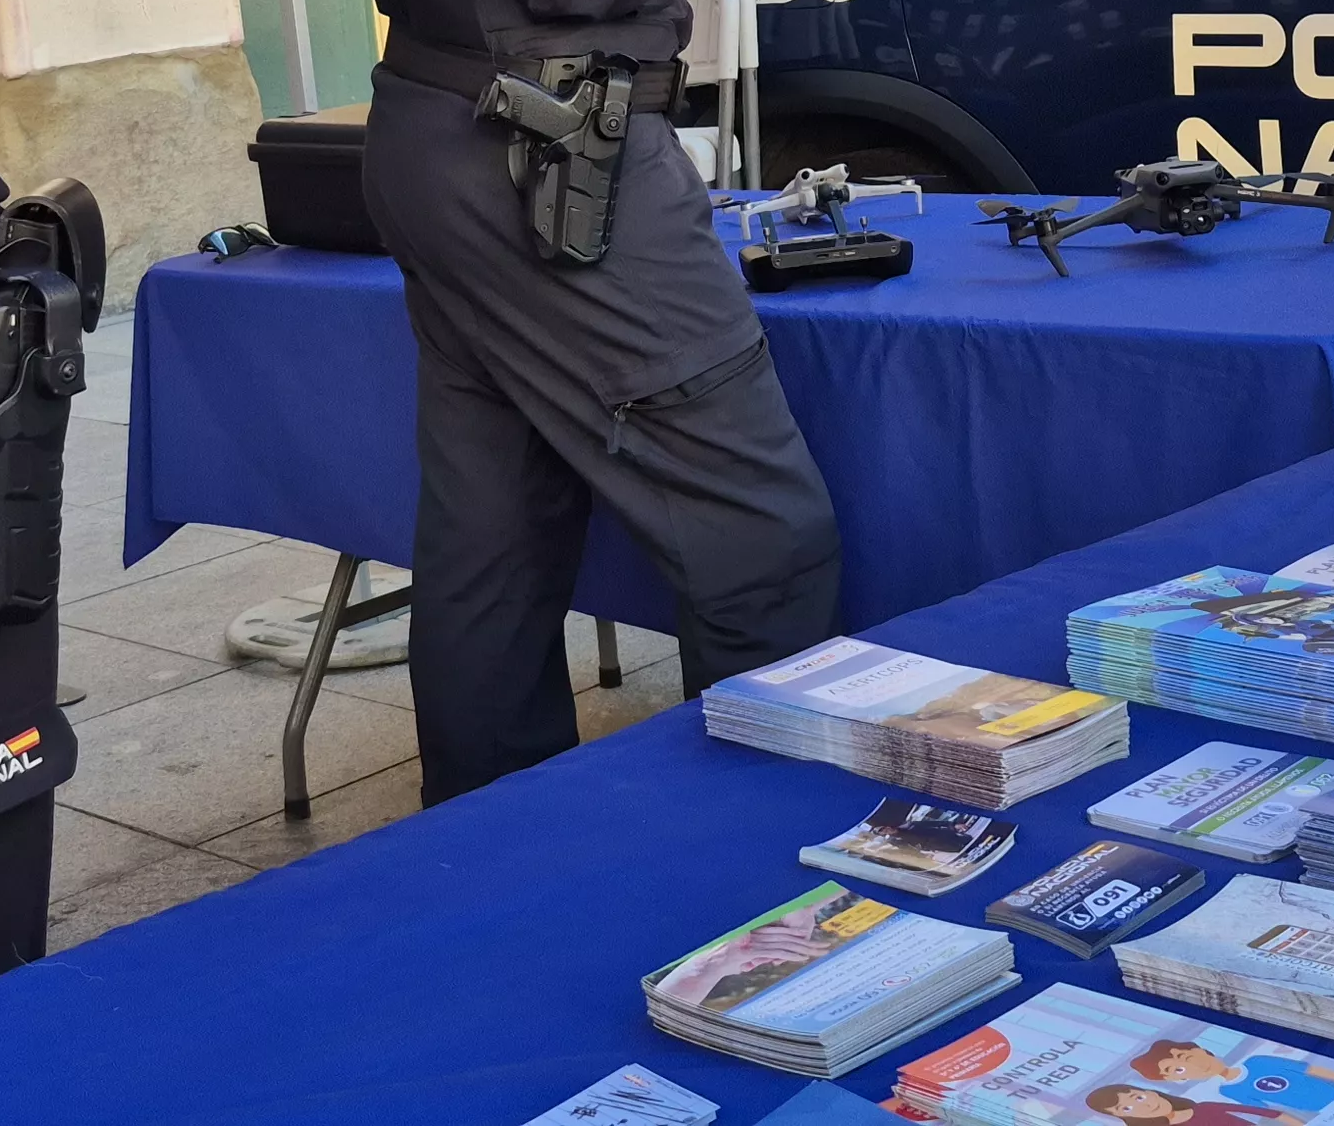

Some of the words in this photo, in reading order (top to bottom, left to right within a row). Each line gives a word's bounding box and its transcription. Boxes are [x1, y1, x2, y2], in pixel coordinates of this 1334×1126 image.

[827, 657, 924, 696] ALERTCOPS
[1124, 773, 1178, 799] PLAN
[1153, 767, 1221, 799] MAYOR
[1167, 757, 1264, 808] SEGURIDAD
[1031, 845, 1120, 897] NACIONAL
[1092, 885, 1131, 907] 091
[981, 1039, 1085, 1091] CONTROLA
[1007, 1085, 1042, 1100] TU
[1035, 1064, 1081, 1088] RED
